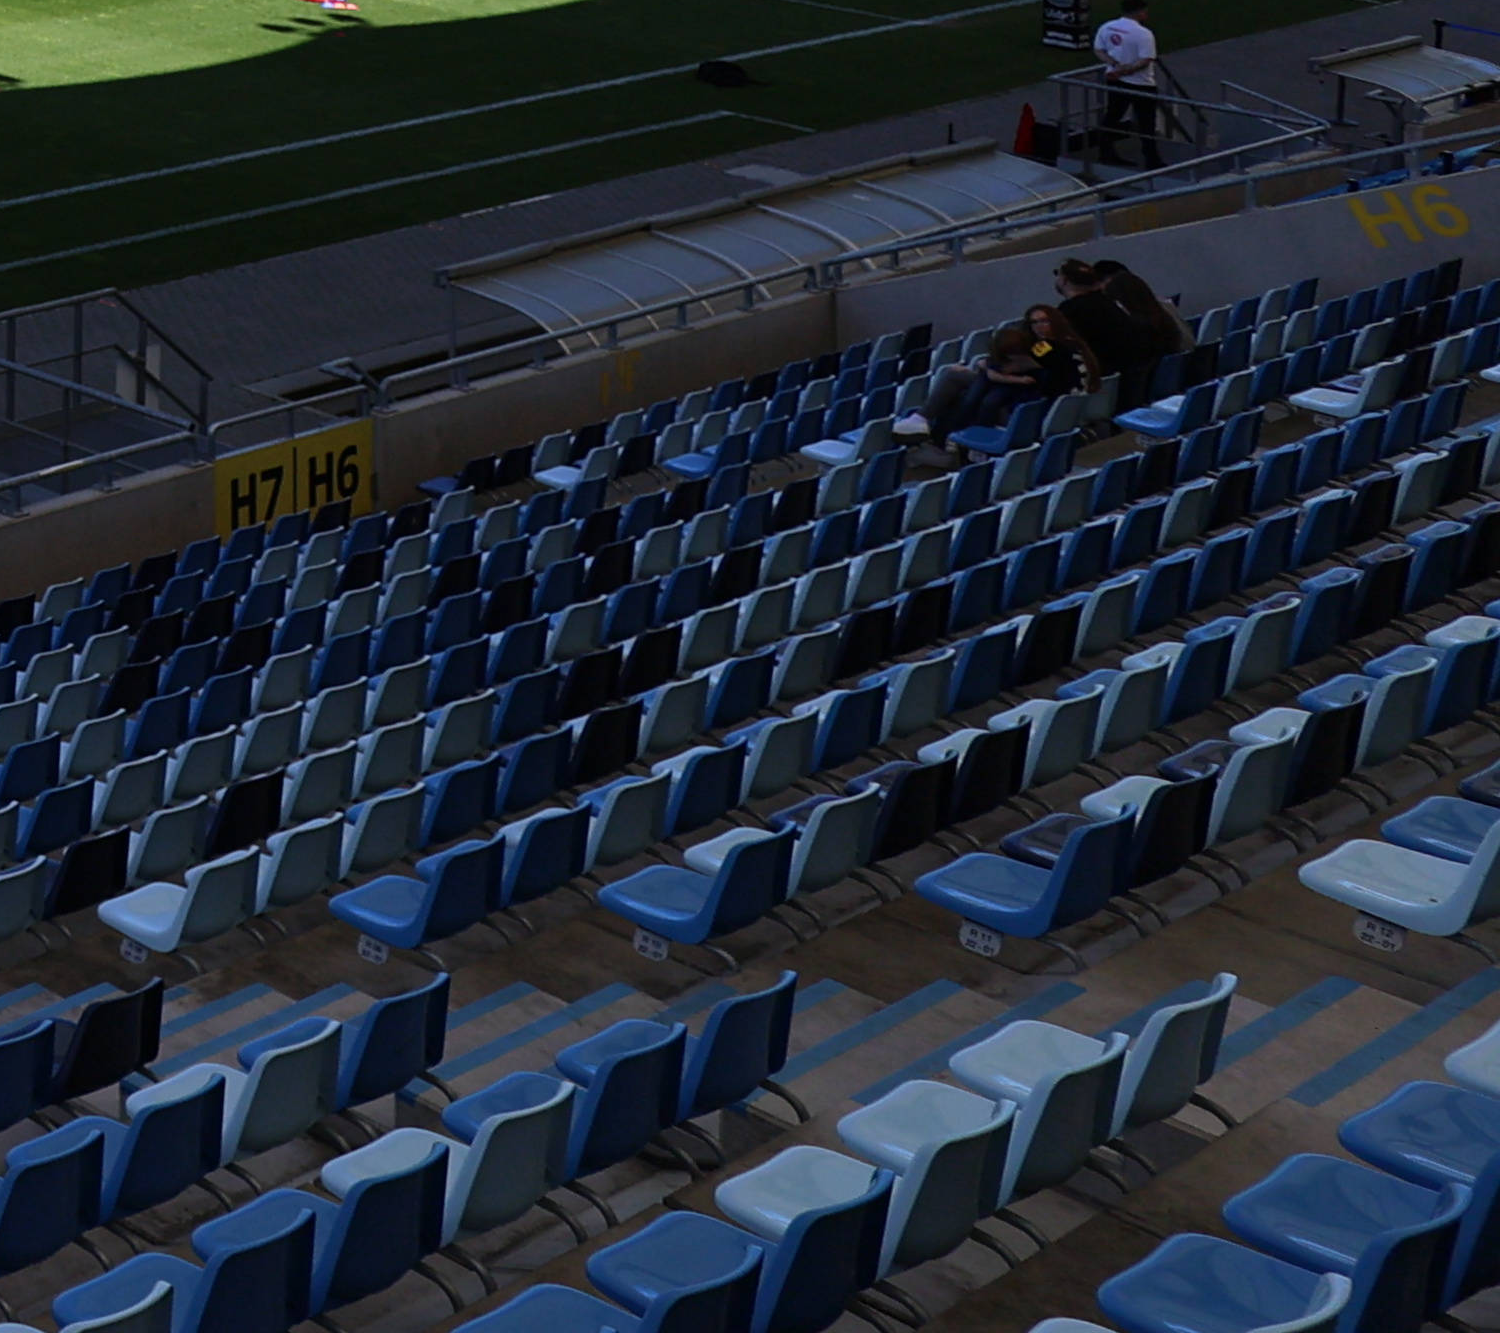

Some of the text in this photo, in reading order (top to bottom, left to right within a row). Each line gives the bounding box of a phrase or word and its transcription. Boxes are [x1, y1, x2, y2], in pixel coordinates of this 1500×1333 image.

[1350, 185, 1470, 250] H6
[231, 445, 358, 530] H7 H6
